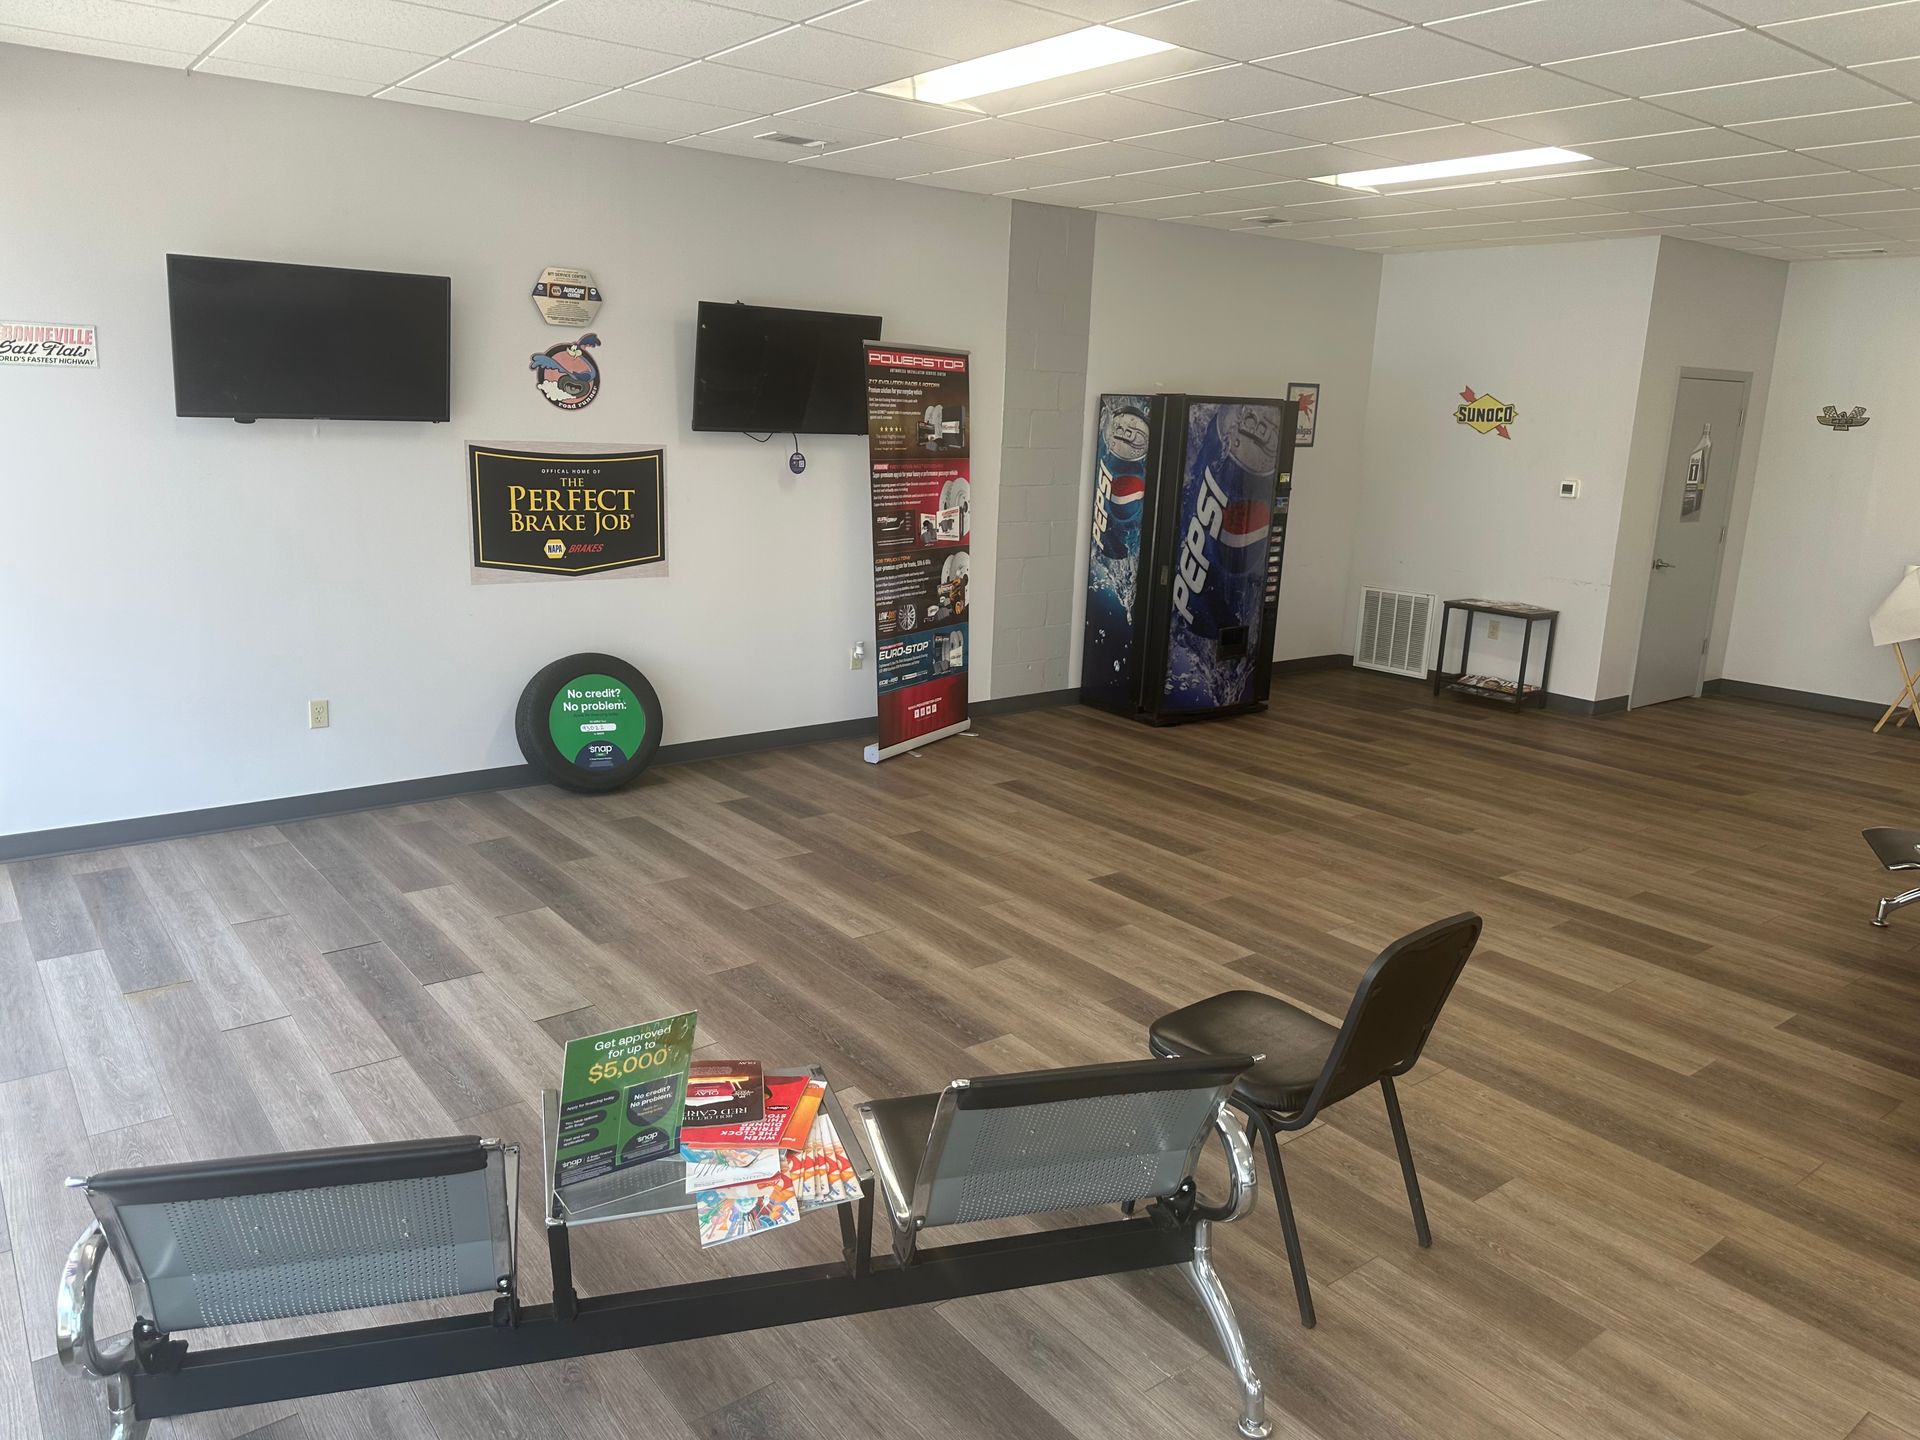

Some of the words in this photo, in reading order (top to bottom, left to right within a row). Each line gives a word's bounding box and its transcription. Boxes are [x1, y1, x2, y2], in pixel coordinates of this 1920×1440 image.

[1, 325, 93, 345] BONNEVILLE
[0, 339, 39, 355] Salt
[42, 341, 90, 357] Flats
[0, 355, 26, 363] ORLD'S
[27, 356, 58, 364] FASTEST
[59, 358, 95, 366] HIGHWAY
[868, 353, 964, 369] POWERSTOP
[558, 401, 576, 409] road
[578, 385, 598, 408] runner
[1459, 406, 1513, 422] SUNOCO
[560, 477, 584, 487] THE
[507, 485, 635, 512] PERFECT
[1092, 460, 1113, 551] PEPSI
[509, 512, 586, 532] BRAKE
[547, 545, 563, 553] NAPA
[568, 543, 604, 553] BRAKES
[1173, 465, 1228, 625] PEPSI
[878, 641, 929, 660] EURO-STOP
[567, 689, 582, 698] No
[585, 688, 621, 698] credit?
[563, 702, 579, 711] No
[589, 745, 613, 754] snap
[594, 1038, 616, 1051] Get
[618, 1025, 671, 1047] approved
[608, 1048, 625, 1059] for
[627, 1045, 641, 1055] up
[644, 1041, 656, 1050] to
[634, 1093, 644, 1101] No
[645, 1085, 671, 1097] credit?
[630, 1101, 641, 1109] No
[720, 1107, 747, 1115] RED
